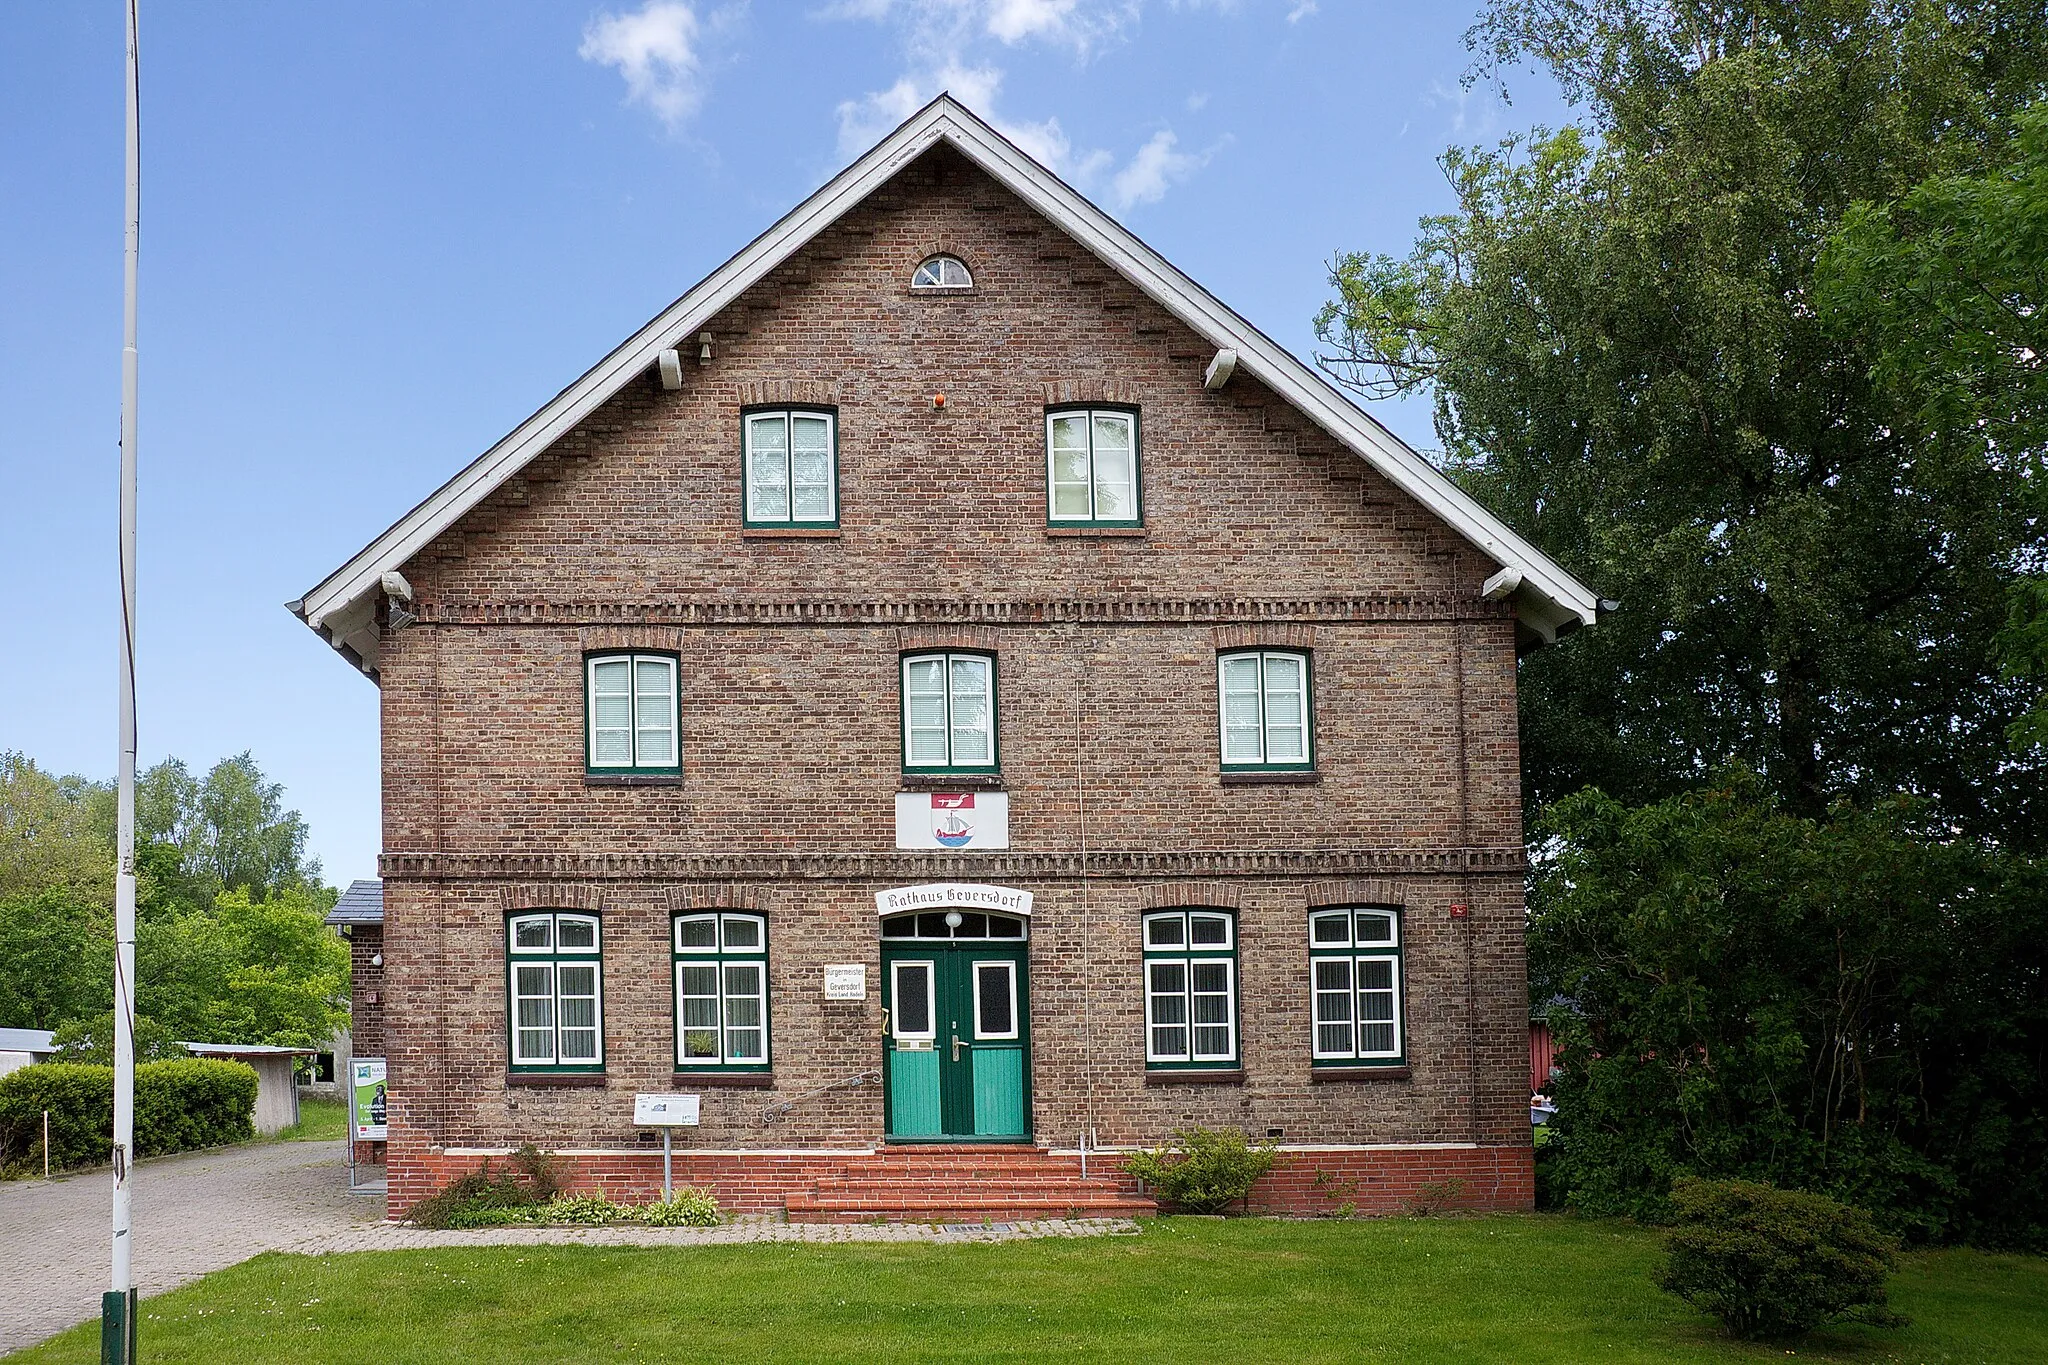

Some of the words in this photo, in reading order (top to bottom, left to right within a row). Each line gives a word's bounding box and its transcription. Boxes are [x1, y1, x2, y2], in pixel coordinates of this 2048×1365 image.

[888, 892, 943, 908] Rathaus
[947, 889, 1022, 908] Geversdorf
[826, 968, 864, 977] Bürgermeister
[830, 983, 861, 991] Geversdorf
